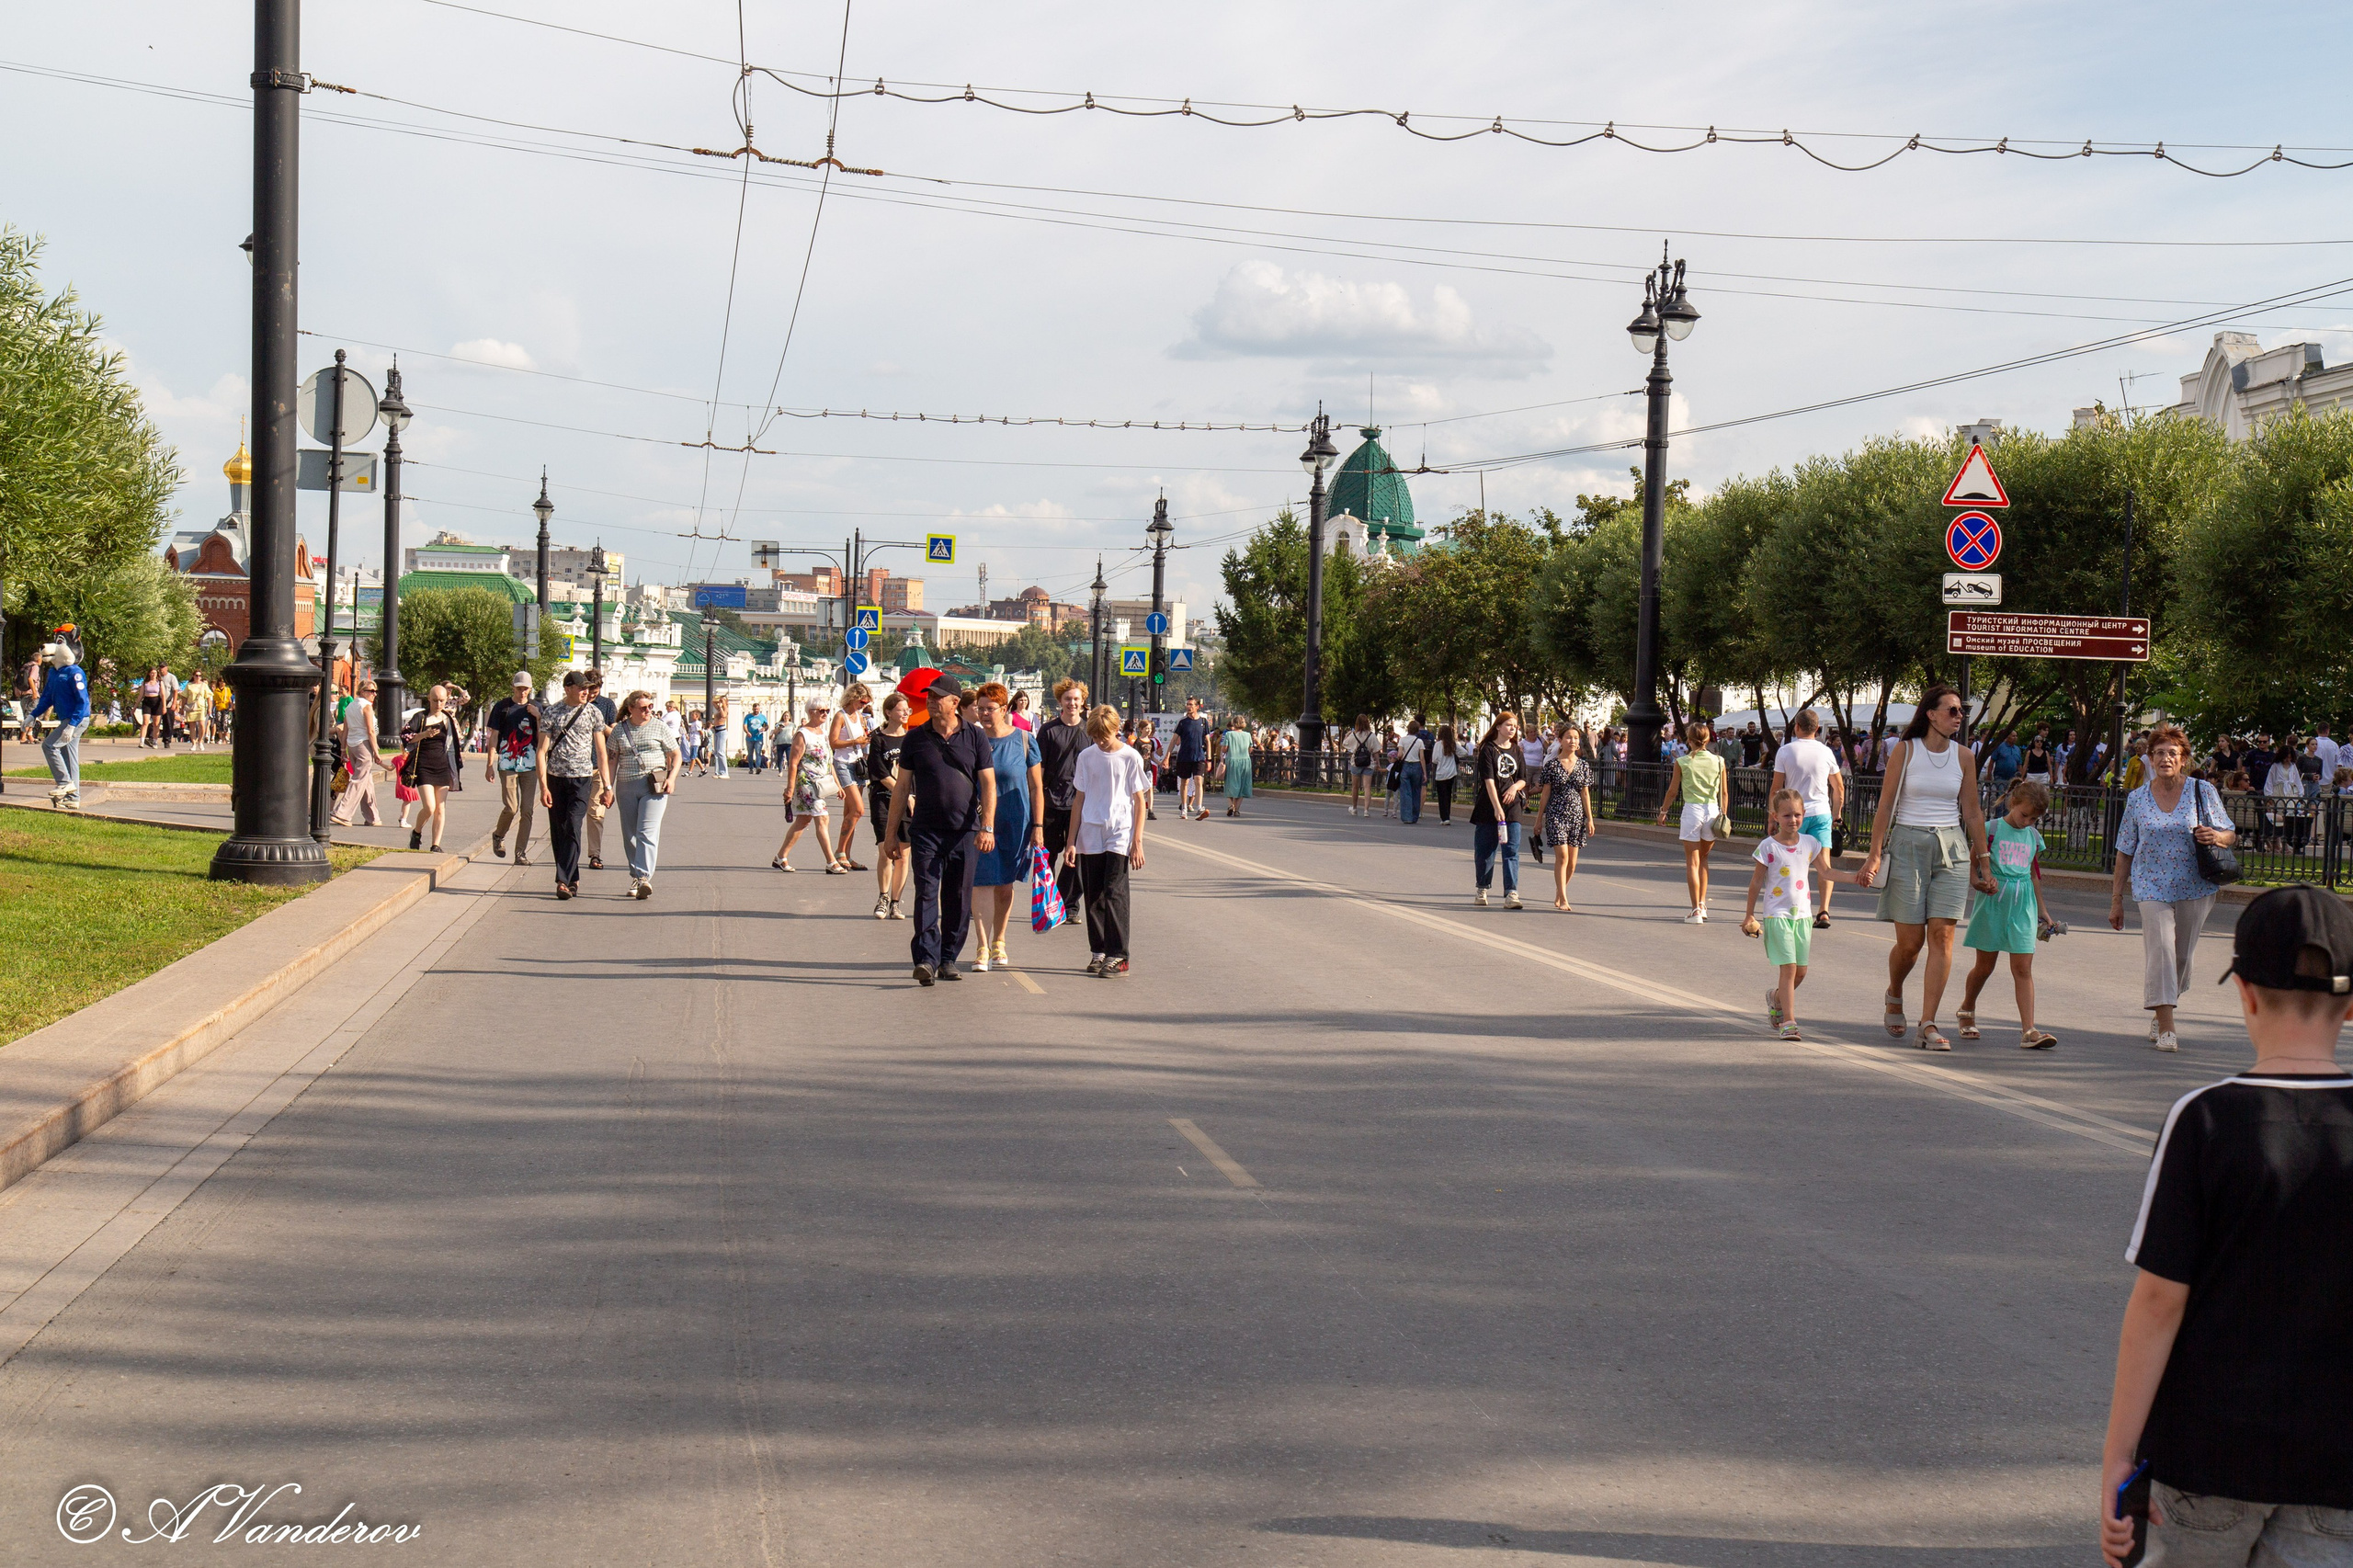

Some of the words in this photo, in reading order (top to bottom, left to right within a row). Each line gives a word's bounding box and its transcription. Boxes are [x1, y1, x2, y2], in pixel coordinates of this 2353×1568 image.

[1967, 616, 2018, 625] ТУРИСТСКИЙ
[2021, 619, 2099, 629] ИНФОРМАЦИОННЫЙ
[2004, 625, 2057, 634] INFORMATION
[2022, 638, 2082, 647] ПРОСВЕЩЕНИЯ
[2009, 645, 2054, 653] EDUCATION
[1999, 840, 2031, 856] STATEN
[1999, 850, 2029, 868] ISLAND
